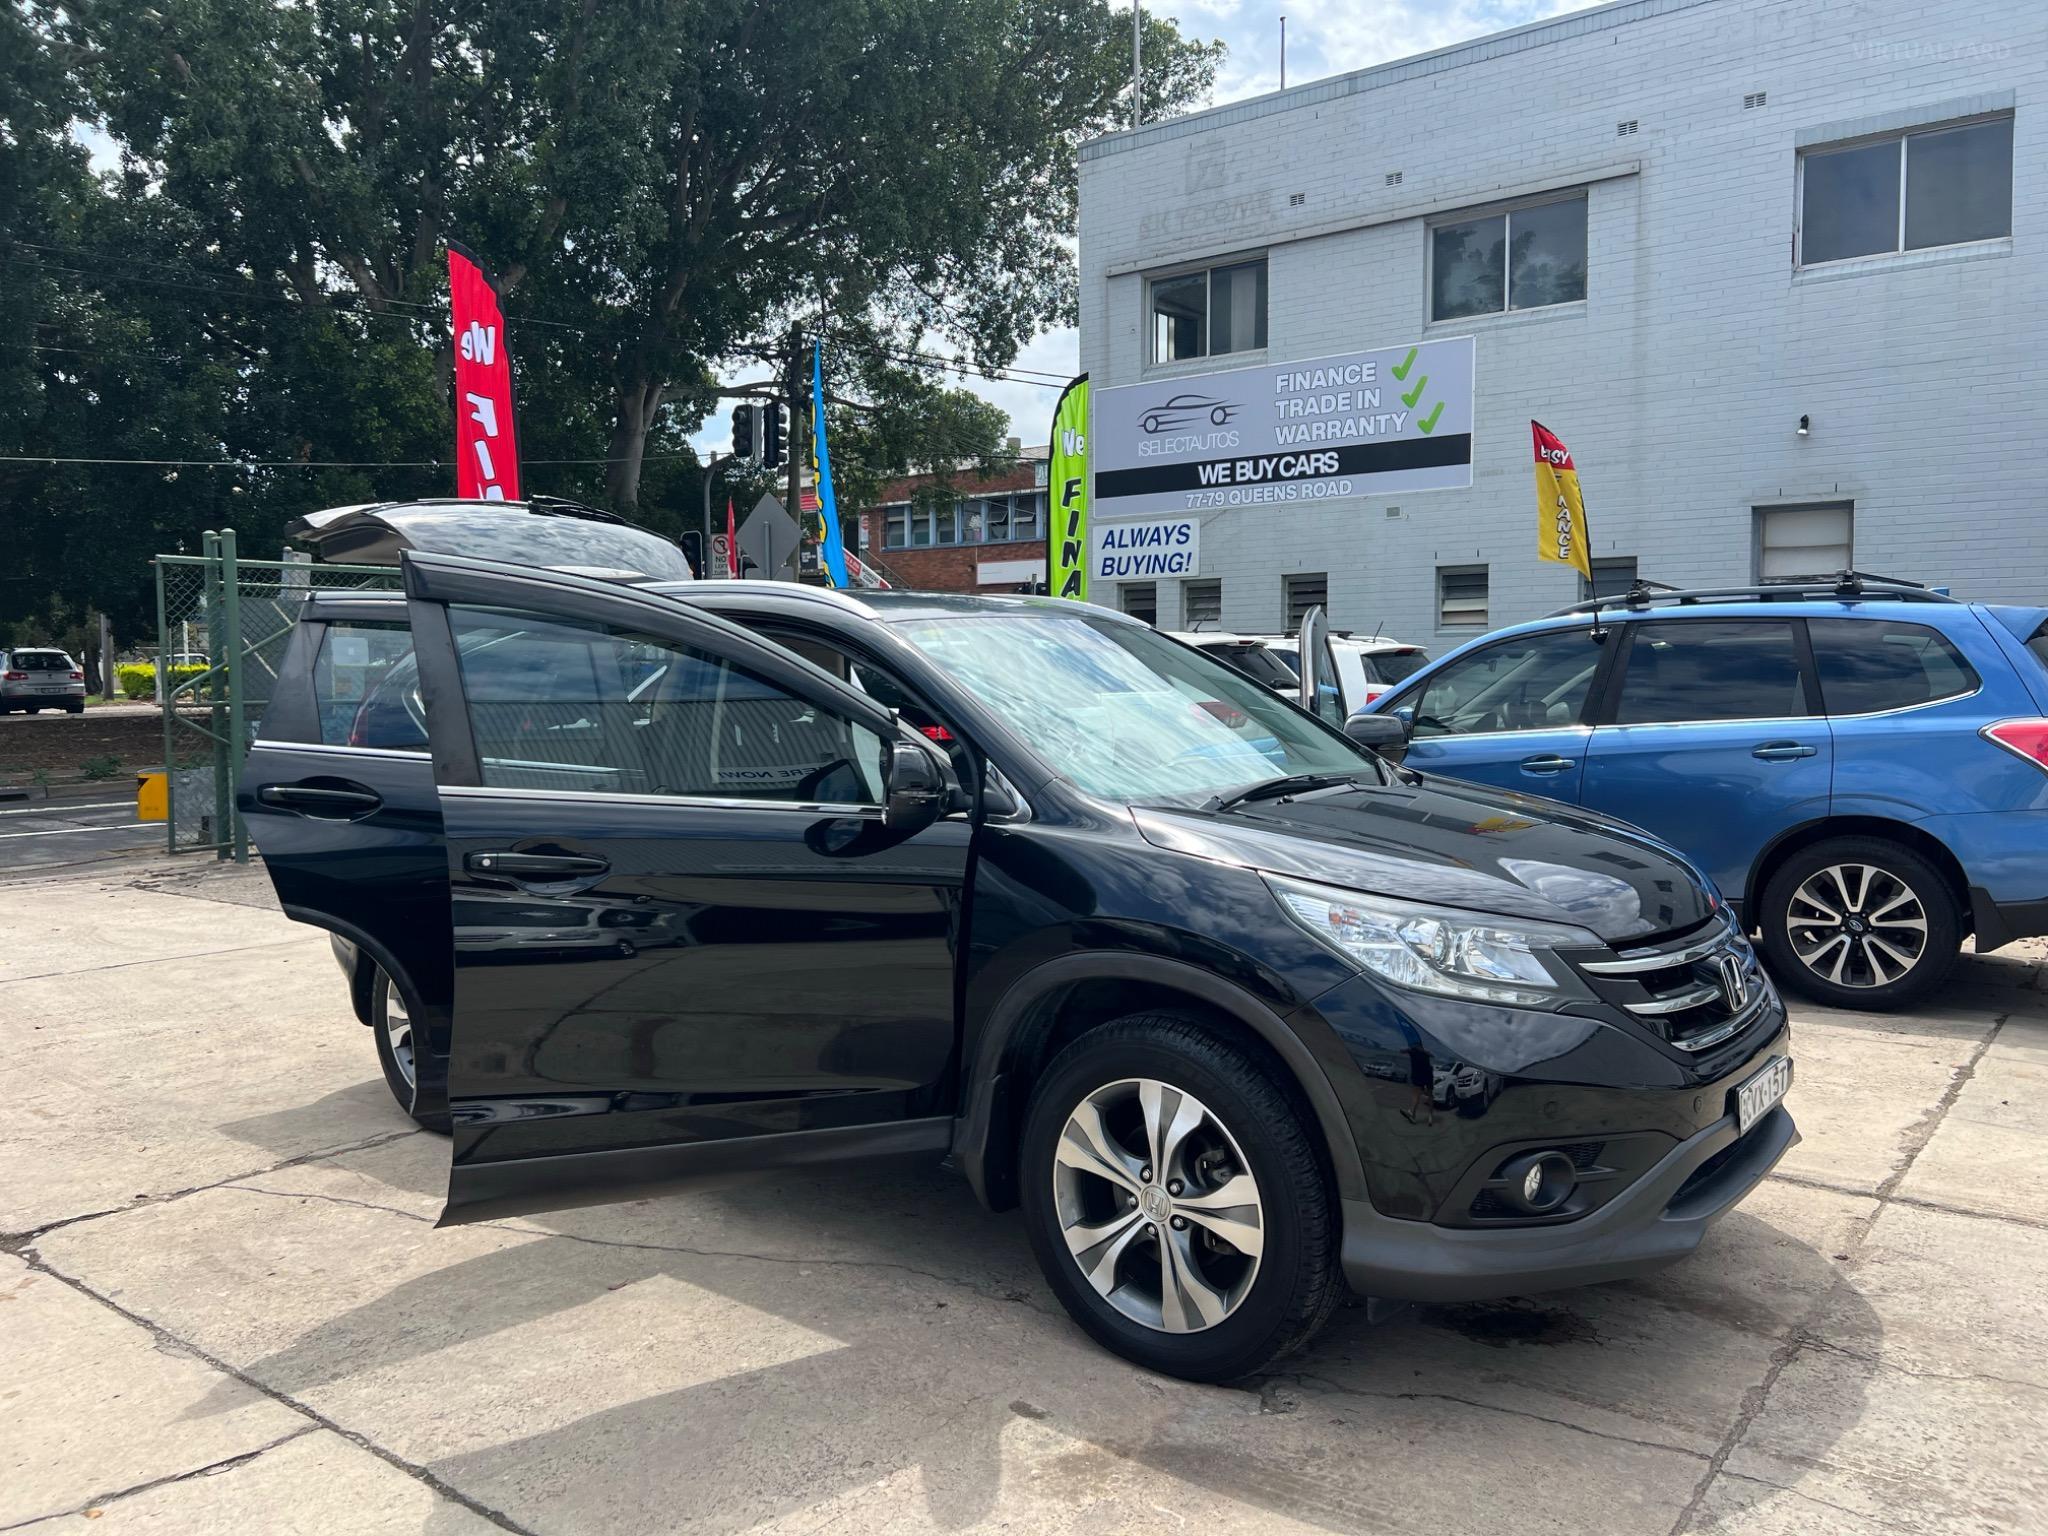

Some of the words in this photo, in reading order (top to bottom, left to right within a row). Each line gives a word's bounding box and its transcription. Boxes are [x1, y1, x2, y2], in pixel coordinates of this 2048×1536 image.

[1275, 361, 1377, 394] FINANCE
[1275, 391, 1351, 419] TRADE
[1357, 387, 1382, 410] IN
[1063, 427, 1085, 457] We
[1138, 430, 1240, 457] ISELECTAUTOS
[1275, 411, 1409, 446] WARRANTY
[1198, 461, 1231, 485] WE
[1236, 456, 1275, 482] BUY
[1279, 451, 1339, 478] CARS
[1186, 491, 1225, 508] 77-79
[1228, 484, 1298, 506] QUEENS
[1301, 480, 1353, 500] ROAD
[1101, 523, 1192, 550] ALWAYS
[1100, 552, 1192, 577] BUYING!
